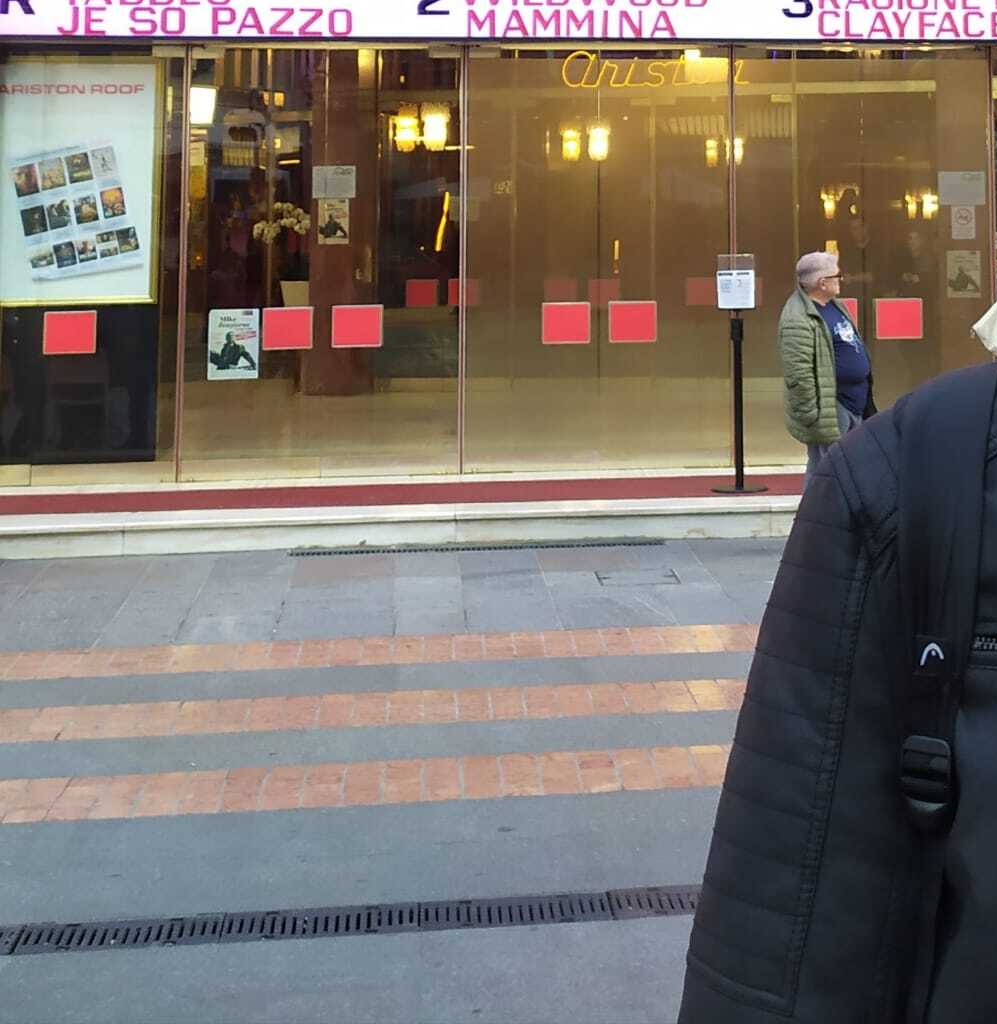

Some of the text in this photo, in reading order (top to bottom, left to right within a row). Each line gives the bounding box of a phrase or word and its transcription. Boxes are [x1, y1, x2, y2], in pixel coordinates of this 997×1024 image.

[57, 6, 353, 36] JE SO PAZZO
[467, 9, 677, 38] MAMMINA
[0, 83, 145, 95] ARISTON ROOF
